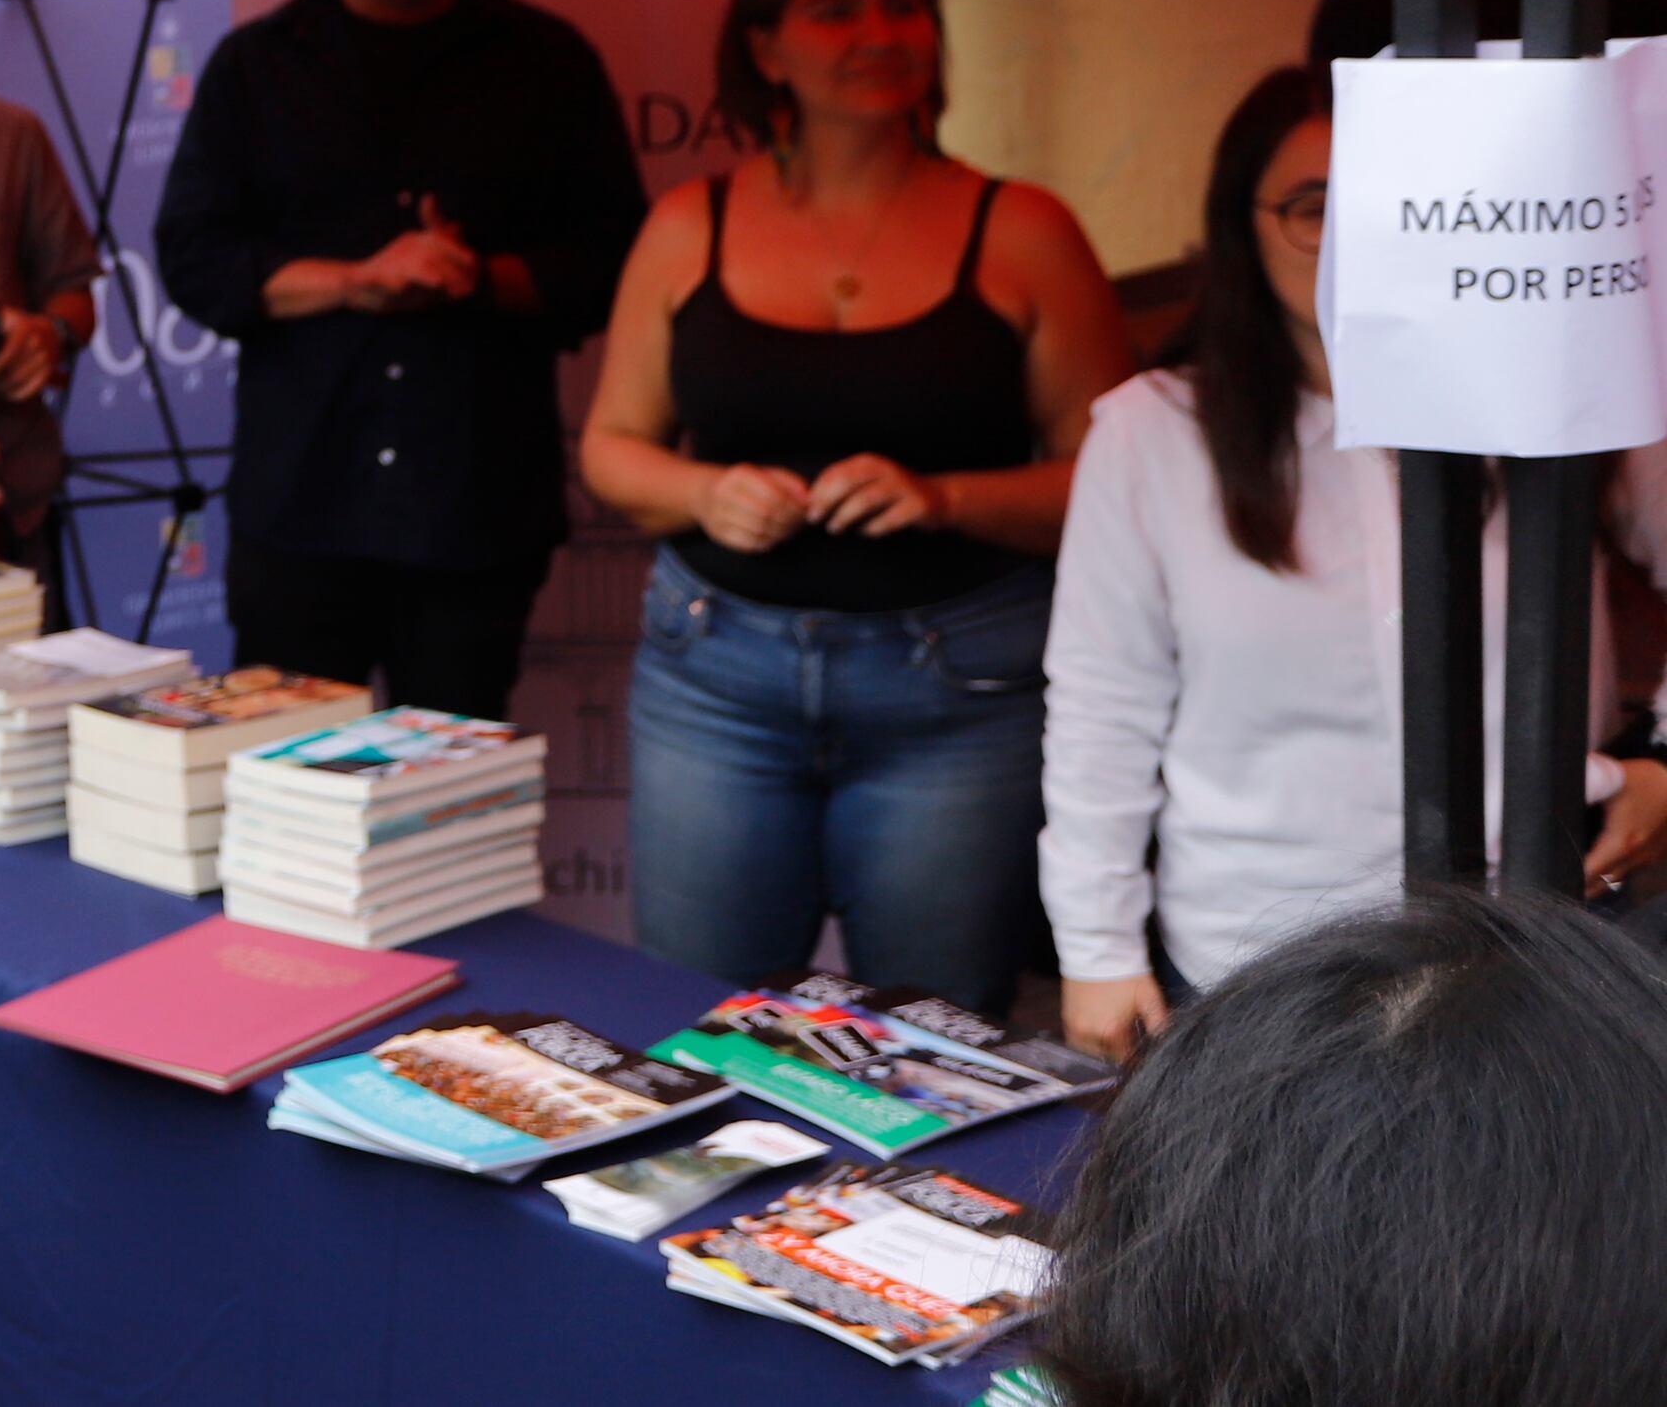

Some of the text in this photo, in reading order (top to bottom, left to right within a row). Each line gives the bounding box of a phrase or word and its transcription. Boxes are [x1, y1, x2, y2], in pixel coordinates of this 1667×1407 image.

[1400, 189, 1605, 233] MÁXIMO
[1615, 193, 1628, 228] 5
[1453, 266, 1548, 301] POR
